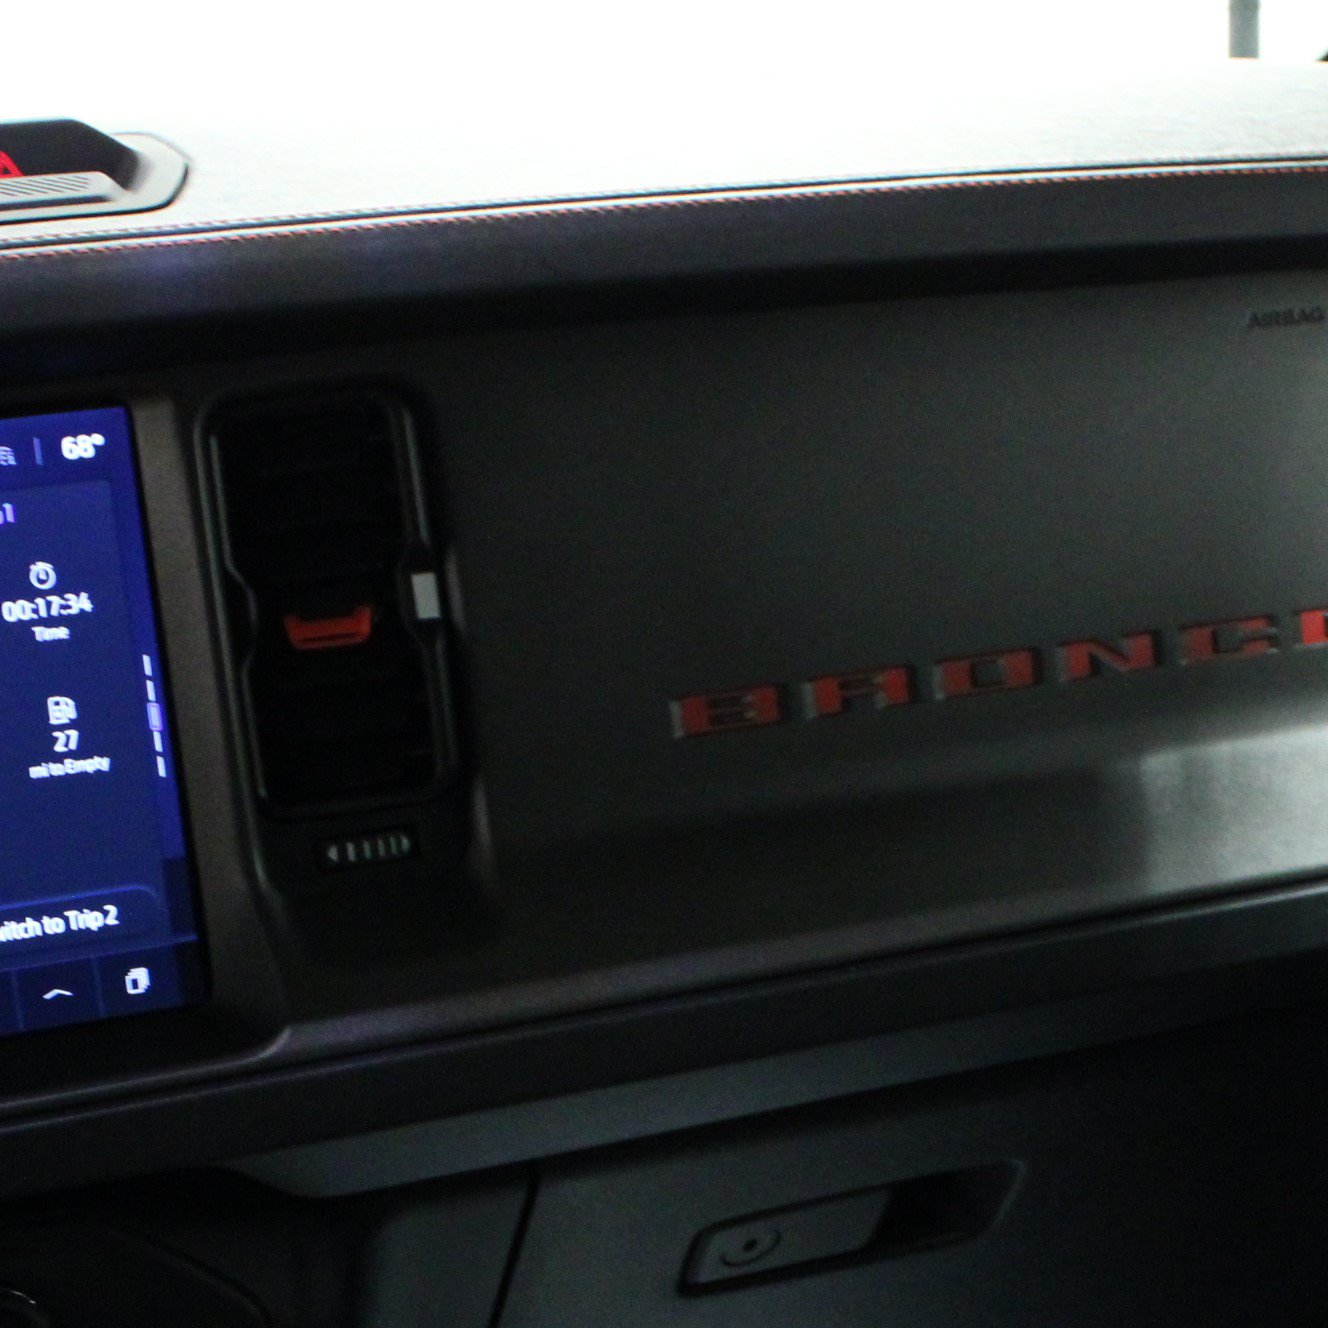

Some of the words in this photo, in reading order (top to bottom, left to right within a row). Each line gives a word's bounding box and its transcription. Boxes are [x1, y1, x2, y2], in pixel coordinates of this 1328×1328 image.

[1, 592, 94, 623] 00:17:34
[52, 729, 79, 753] 27
[42, 916, 65, 935] to
[64, 908, 105, 931] Trip
[103, 904, 119, 925] 2
